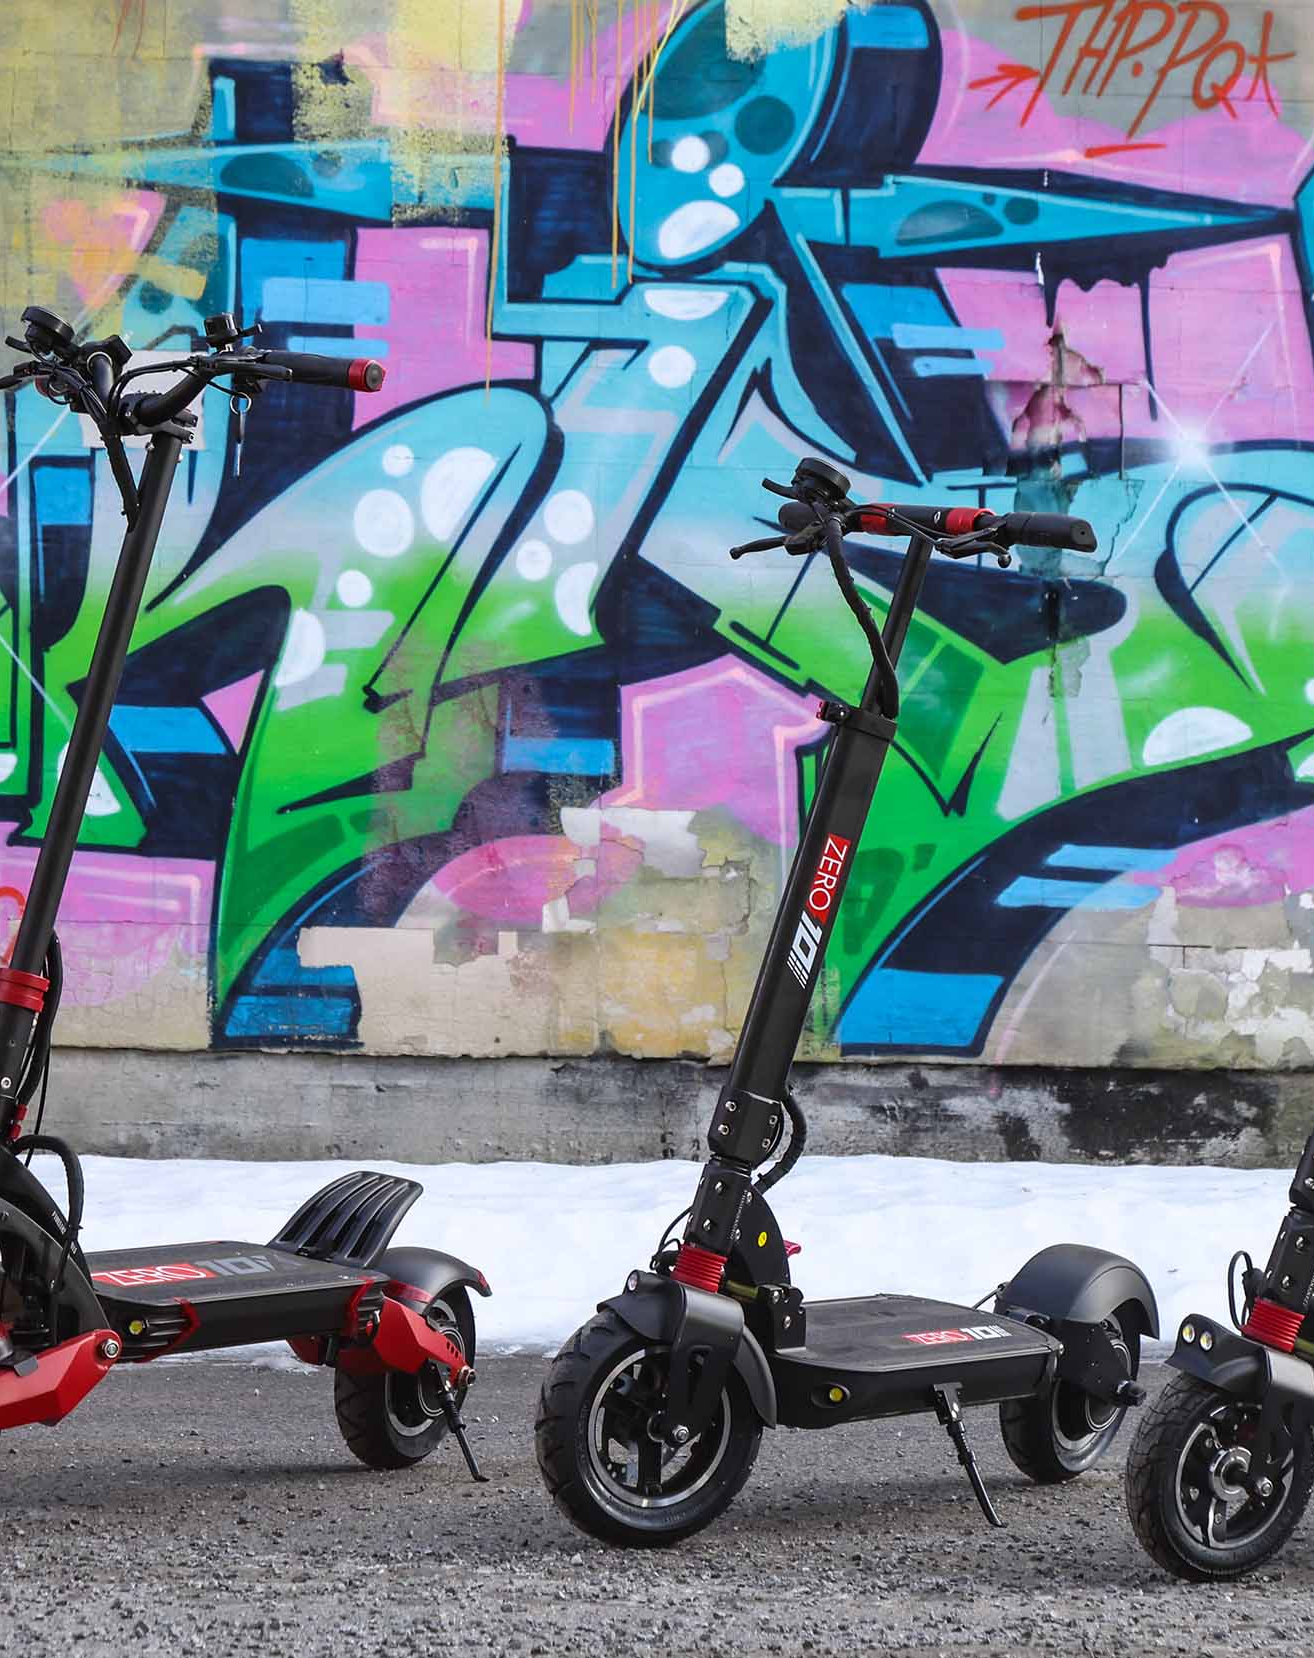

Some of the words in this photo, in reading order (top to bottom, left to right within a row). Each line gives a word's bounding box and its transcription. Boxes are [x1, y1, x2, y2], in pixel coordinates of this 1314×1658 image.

[809, 837, 848, 911] ZERO
[792, 911, 823, 973] 10
[91, 1265, 206, 1286] ZERO
[902, 1330, 969, 1344] ZERO
